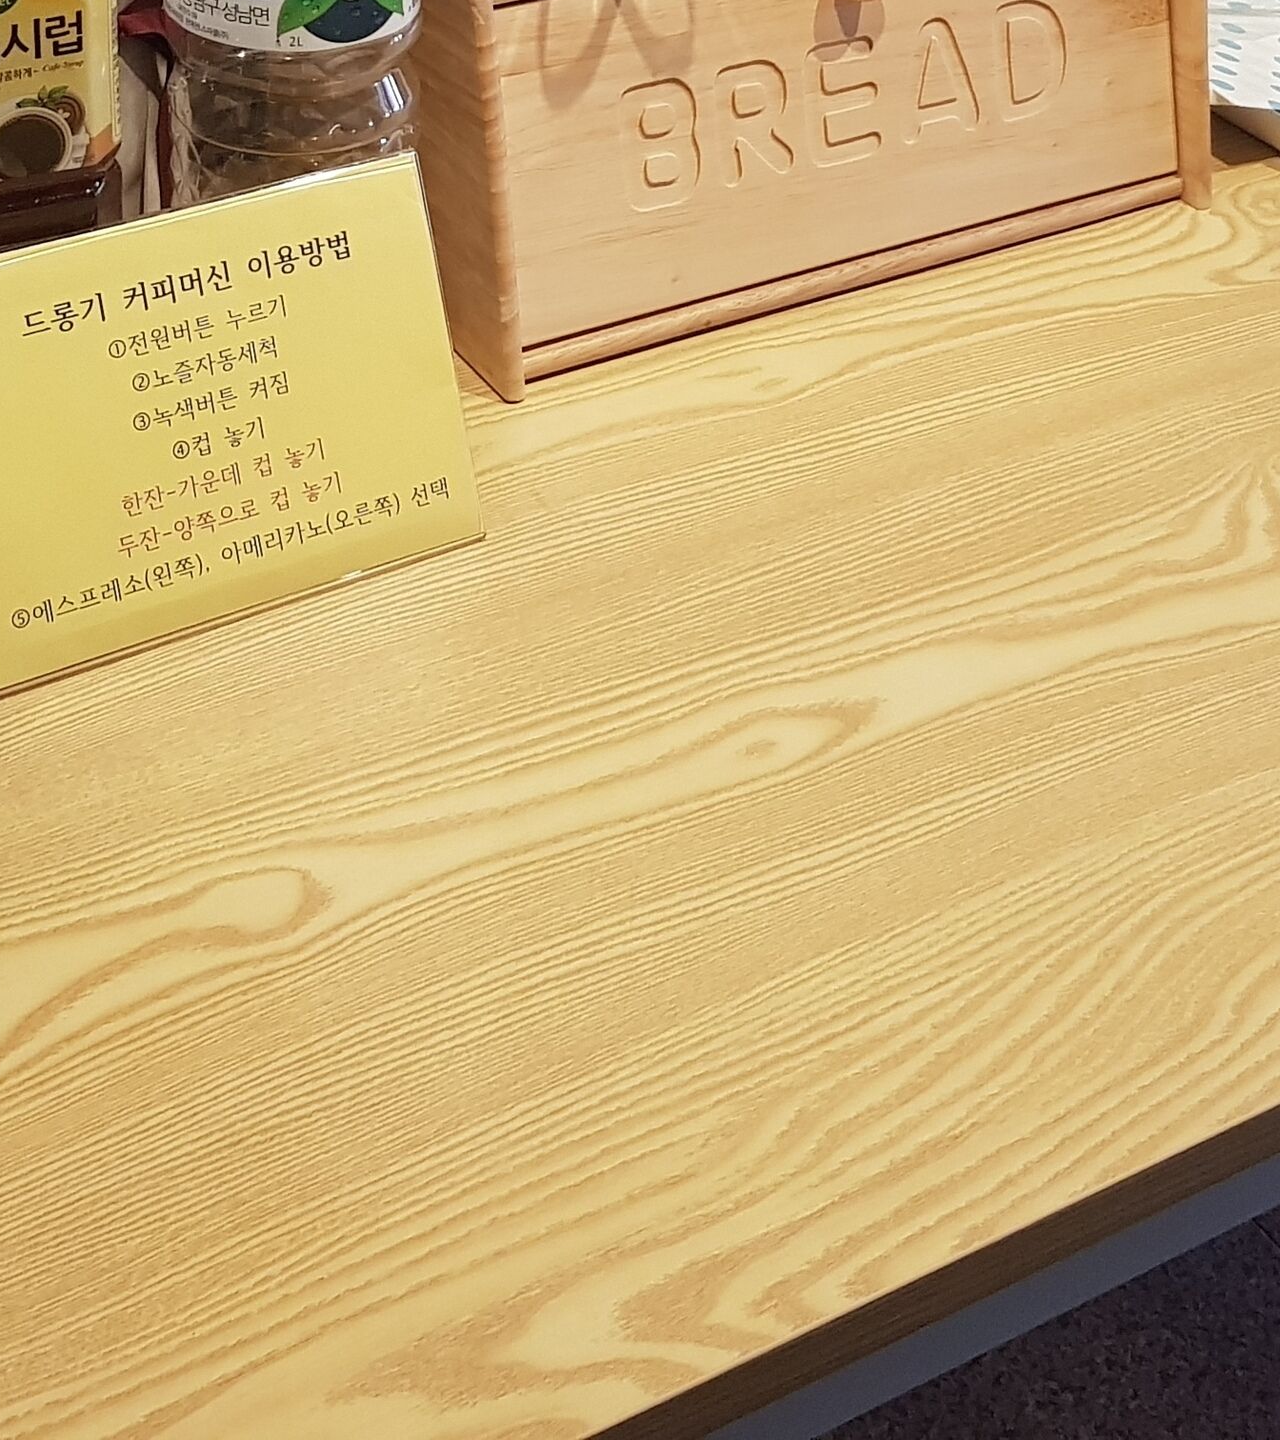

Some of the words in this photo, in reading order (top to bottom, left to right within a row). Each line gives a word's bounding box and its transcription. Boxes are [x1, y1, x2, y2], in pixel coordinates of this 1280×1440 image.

[289, 35, 304, 48] 2L
[21, 292, 107, 338] 드롱기
[122, 260, 233, 312] 커피머신
[247, 230, 352, 280] 이용방법
[225, 294, 289, 332] 누르기
[248, 370, 290, 401] 켜짐
[223, 416, 266, 448] 놓기
[121, 461, 242, 518] 한잔-가운데
[252, 452, 273, 478] 컵
[284, 437, 326, 469] 놓기
[117, 497, 260, 559] 두잔-양쪽으로
[269, 486, 290, 512] 컵
[301, 470, 343, 504] 놓기
[220, 491, 402, 566] 아메리카노(오른쪽)
[409, 476, 450, 509] 선택
